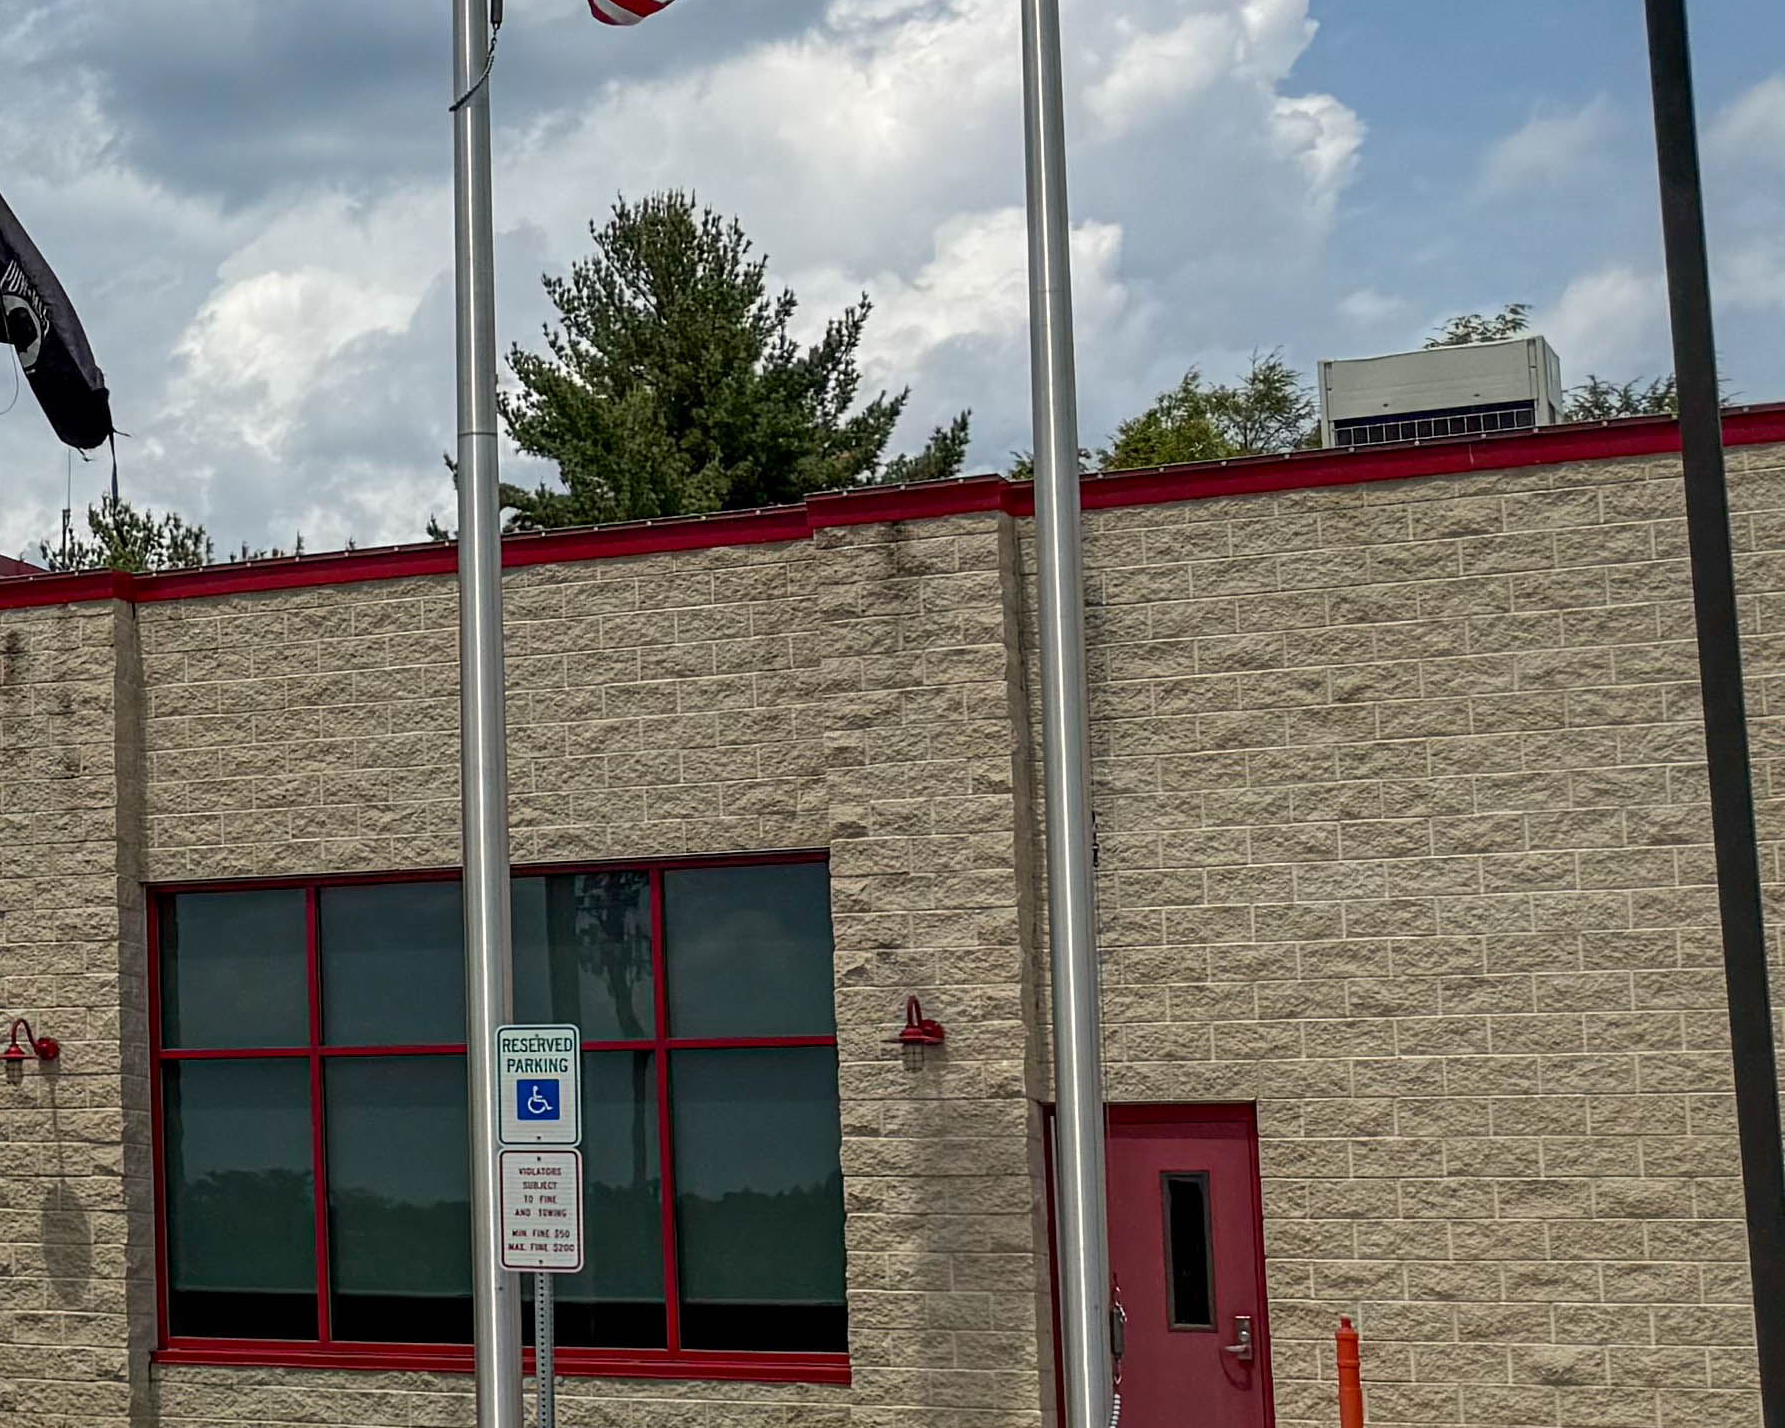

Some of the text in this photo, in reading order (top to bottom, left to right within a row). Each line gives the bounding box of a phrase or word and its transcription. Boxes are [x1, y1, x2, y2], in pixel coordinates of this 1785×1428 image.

[502, 1038, 573, 1052] RESERVED
[507, 1058, 568, 1073] PARKING
[518, 1168, 562, 1176] VIOLATORS
[523, 1181, 557, 1189] SUBJECT
[524, 1194, 557, 1204] TO FINE
[515, 1208, 532, 1217] AND
[532, 1229, 550, 1238] FINE
